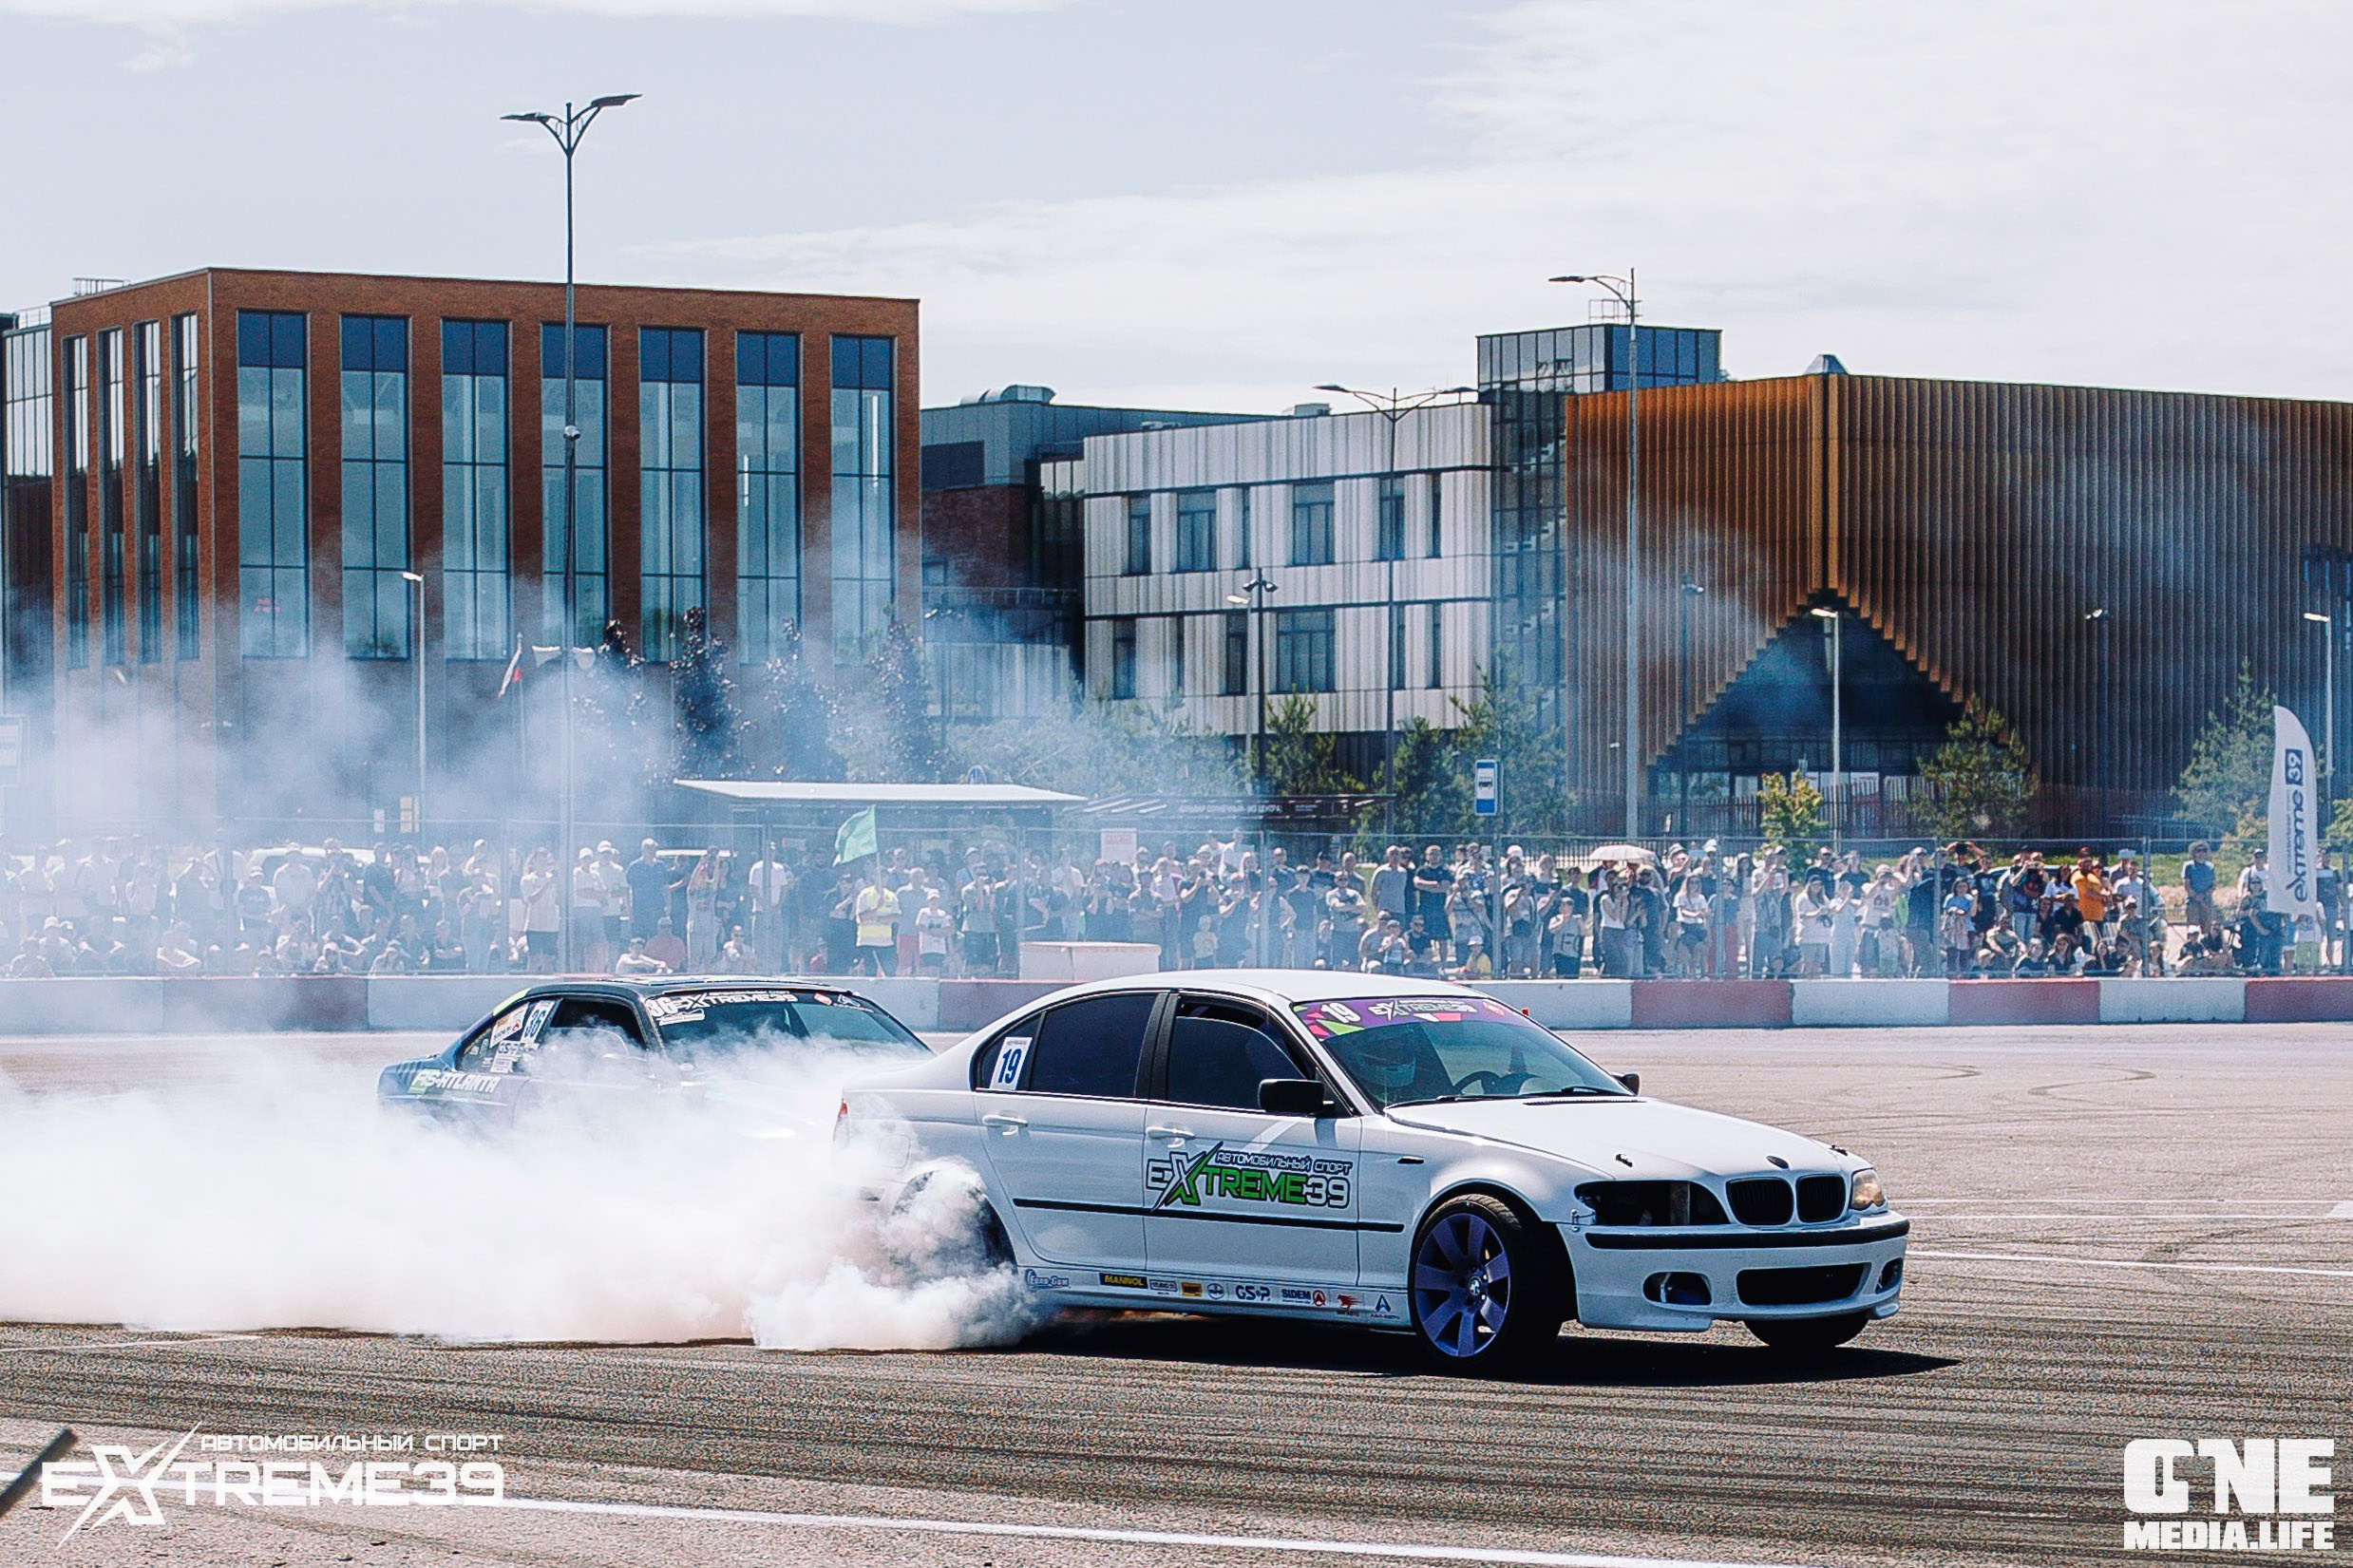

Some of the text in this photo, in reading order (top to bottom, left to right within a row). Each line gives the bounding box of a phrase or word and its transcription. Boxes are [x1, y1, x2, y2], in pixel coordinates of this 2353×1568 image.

[2287, 751, 2302, 783] 39
[524, 1010, 547, 1038] 36
[1322, 1002, 1361, 1025] 19
[997, 1048, 1022, 1085] 19
[1146, 1142, 1352, 1211] EXTREME39
[1215, 1151, 1353, 1176] АВТОМОБИЛЬНЫЙ СПОРТ
[1105, 1275, 1144, 1286] MANNOL
[1281, 1288, 1311, 1300] SIDEM
